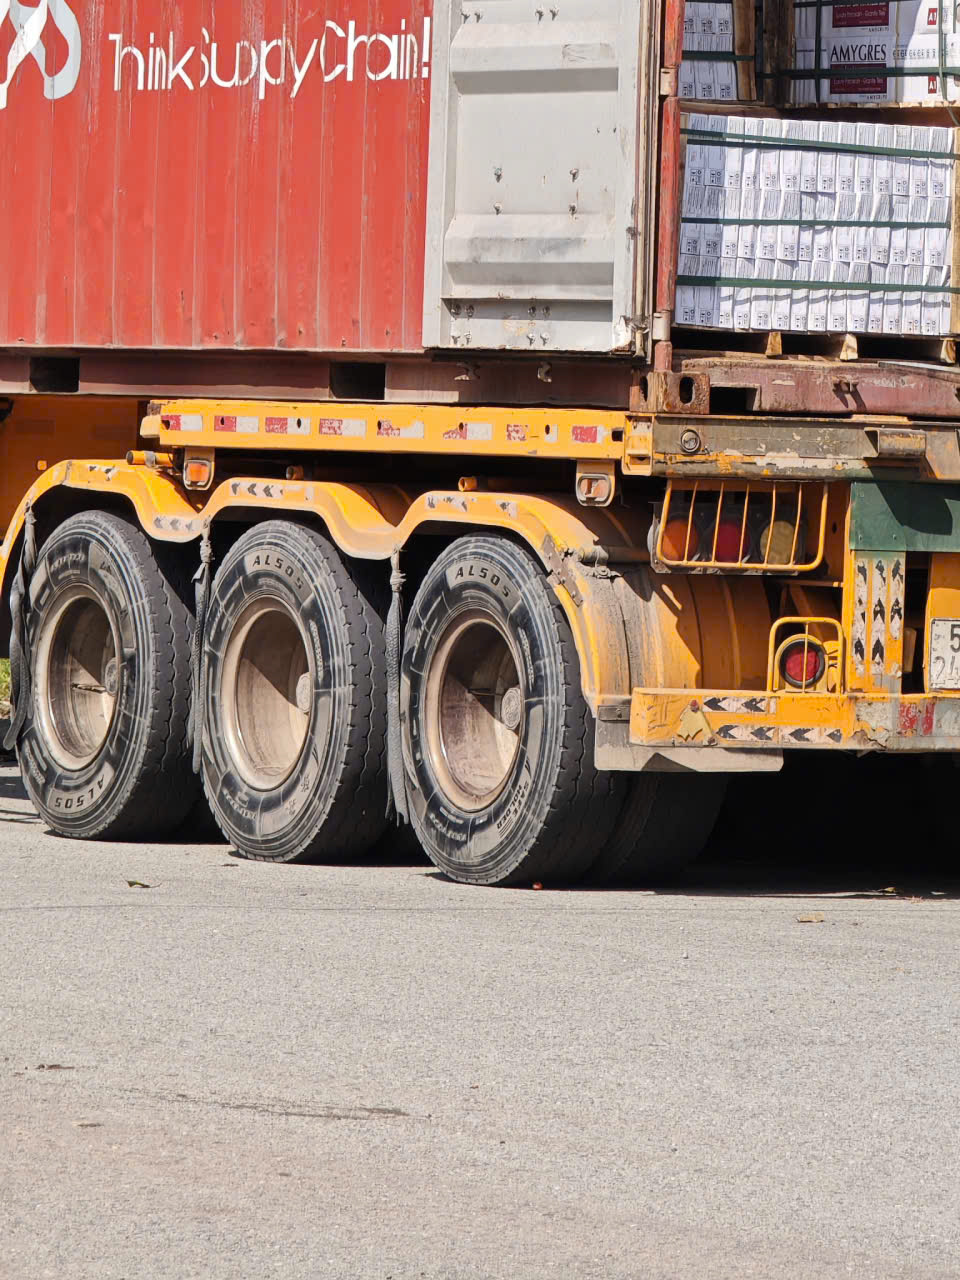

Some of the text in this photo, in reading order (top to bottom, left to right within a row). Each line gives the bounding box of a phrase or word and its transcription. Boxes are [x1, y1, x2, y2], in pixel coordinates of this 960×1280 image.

[108, 31, 196, 91] Think
[320, 16, 431, 82] Chain!
[831, 44, 887, 62] AMYGRES
